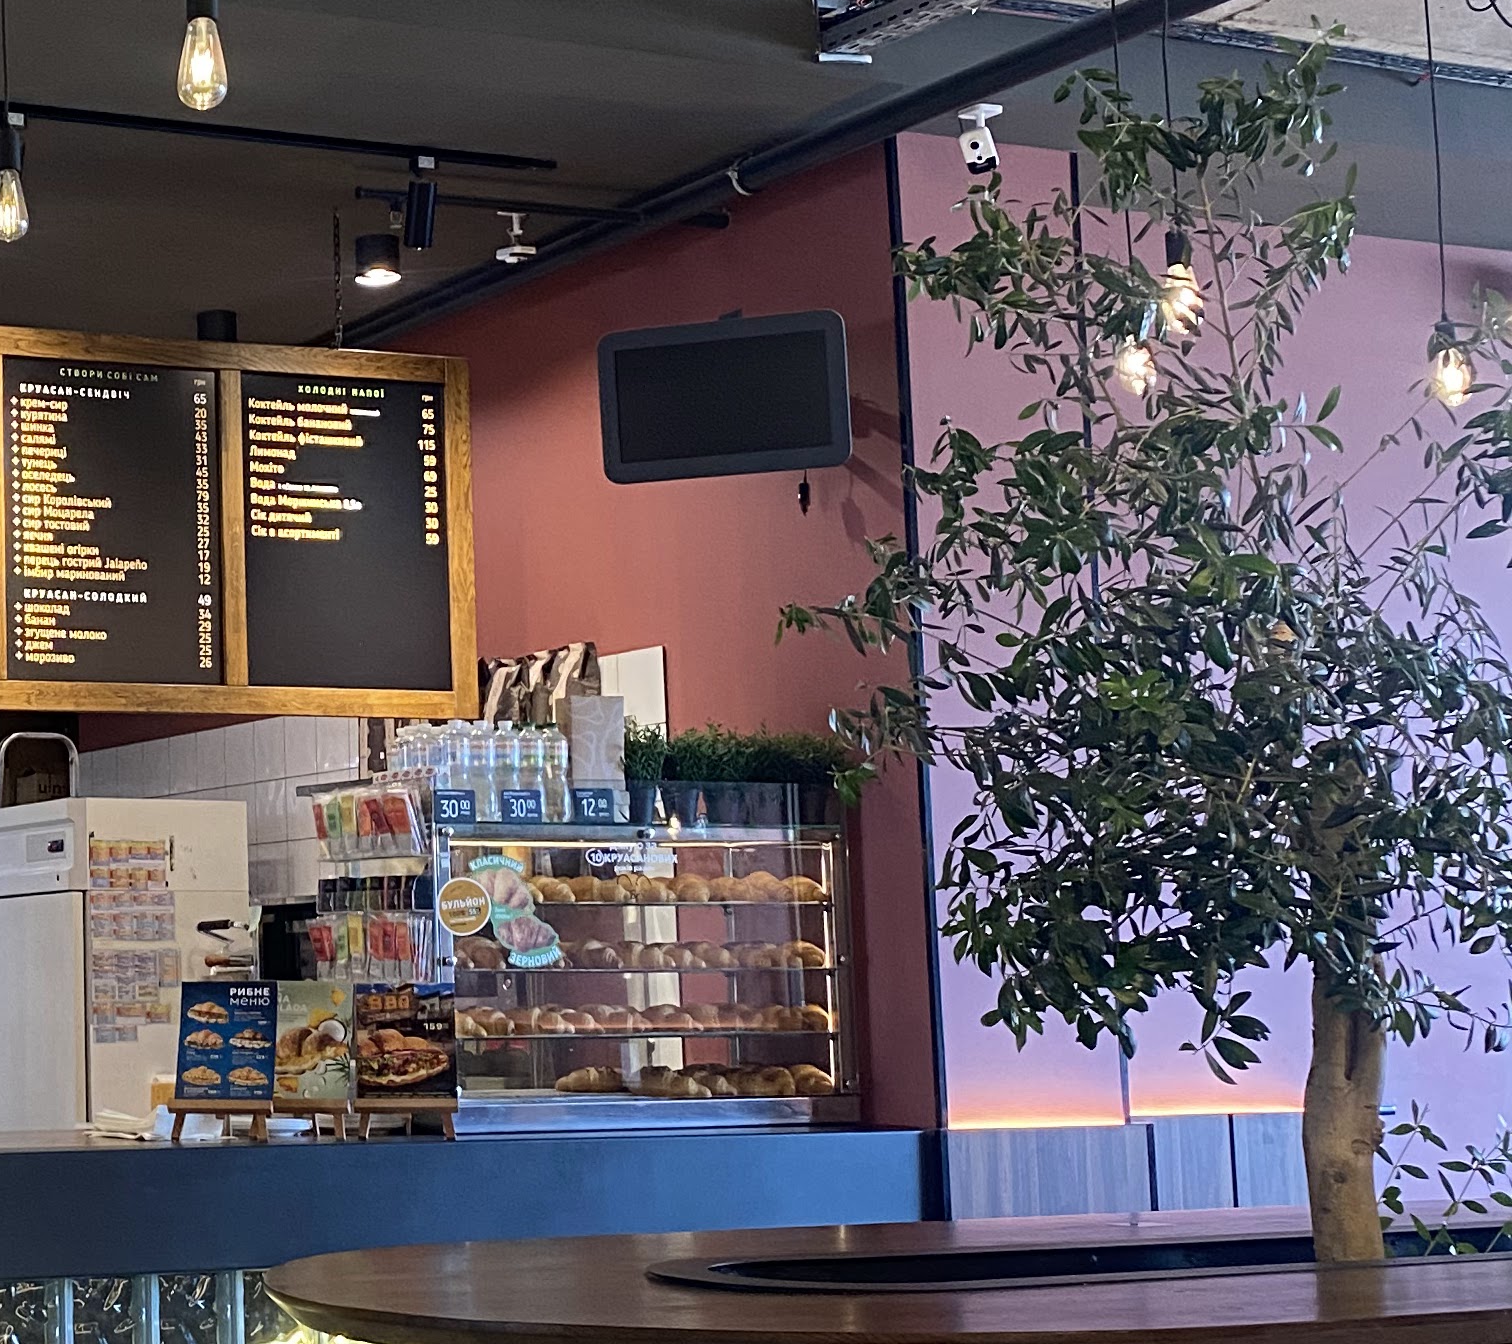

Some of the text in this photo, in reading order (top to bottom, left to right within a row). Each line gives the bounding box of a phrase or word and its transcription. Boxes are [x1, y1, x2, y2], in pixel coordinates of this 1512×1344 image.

[60, 368, 158, 382] СТВОРИ СОБІ САМ
[20, 383, 207, 404] КРУАСАН-СЕНДВІЧ 65
[298, 385, 385, 398] ХОЛОДНІ НАПОЇ
[20, 398, 207, 418] крем-сир 20
[248, 398, 295, 411] Коктейль
[422, 409, 434, 420] 65
[20, 410, 207, 430] курятина 35
[20, 422, 207, 442] шинка 43
[22, 494, 209, 513] сир Королівський 35
[24, 566, 211, 585] імбир маринований 12
[23, 589, 212, 606] КРУАСАН-СОЛОДКИЙ 49
[469, 858, 524, 872] КЛАСИЧНИЙ
[604, 852, 678, 864] КРУАСАНОВИХ
[441, 896, 485, 910] БУЛЬЙОН
[510, 946, 561, 967] ЗЕРНОВИЙ
[230, 988, 270, 996] РИБНЕ
